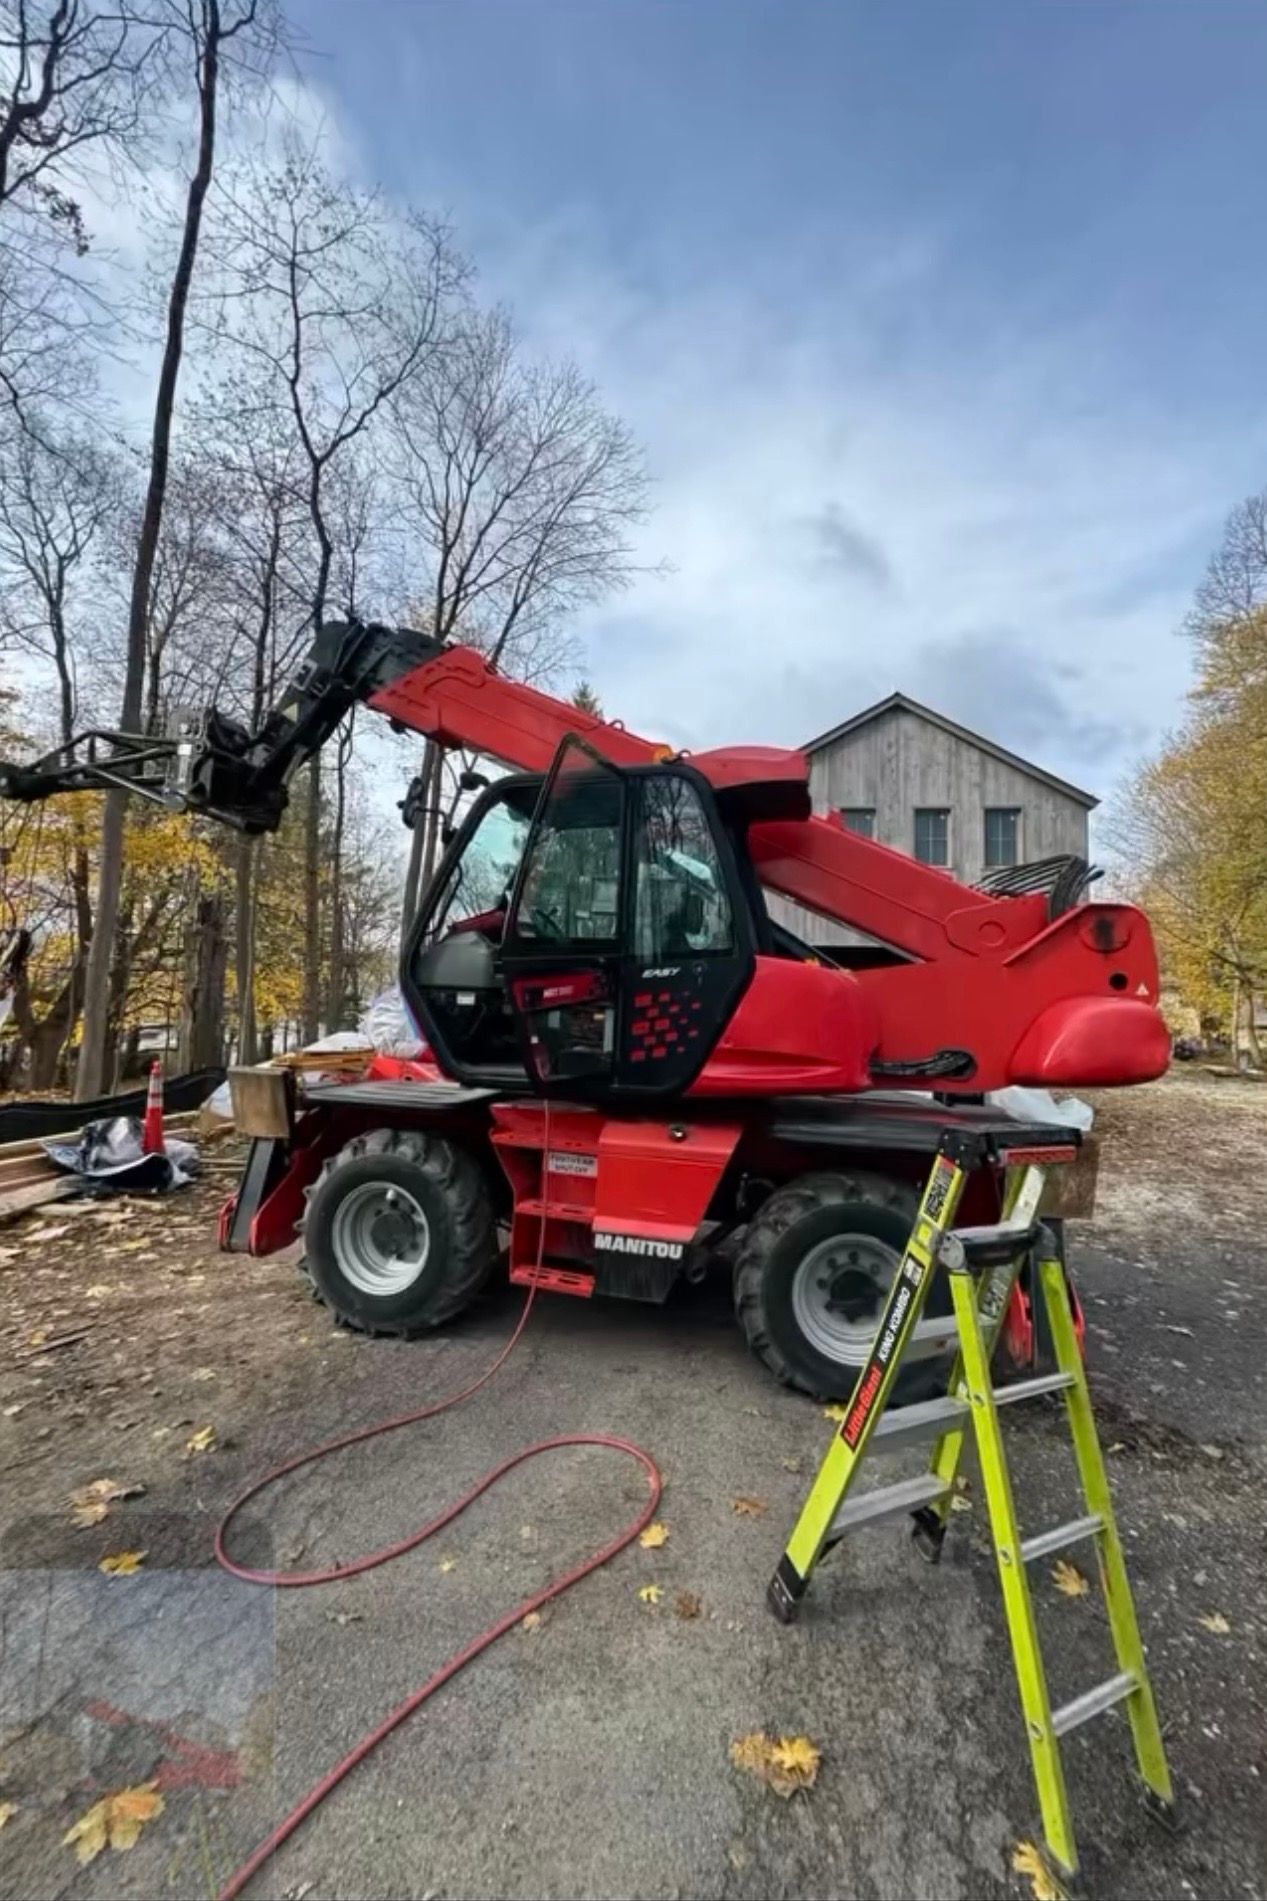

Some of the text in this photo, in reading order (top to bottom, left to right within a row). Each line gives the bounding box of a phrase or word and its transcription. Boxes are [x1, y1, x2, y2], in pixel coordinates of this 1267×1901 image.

[642, 966, 681, 979] EASY
[594, 1233, 684, 1260] MANITOU
[877, 1329, 895, 1363] KING
[889, 1286, 911, 1333] KOMBO
